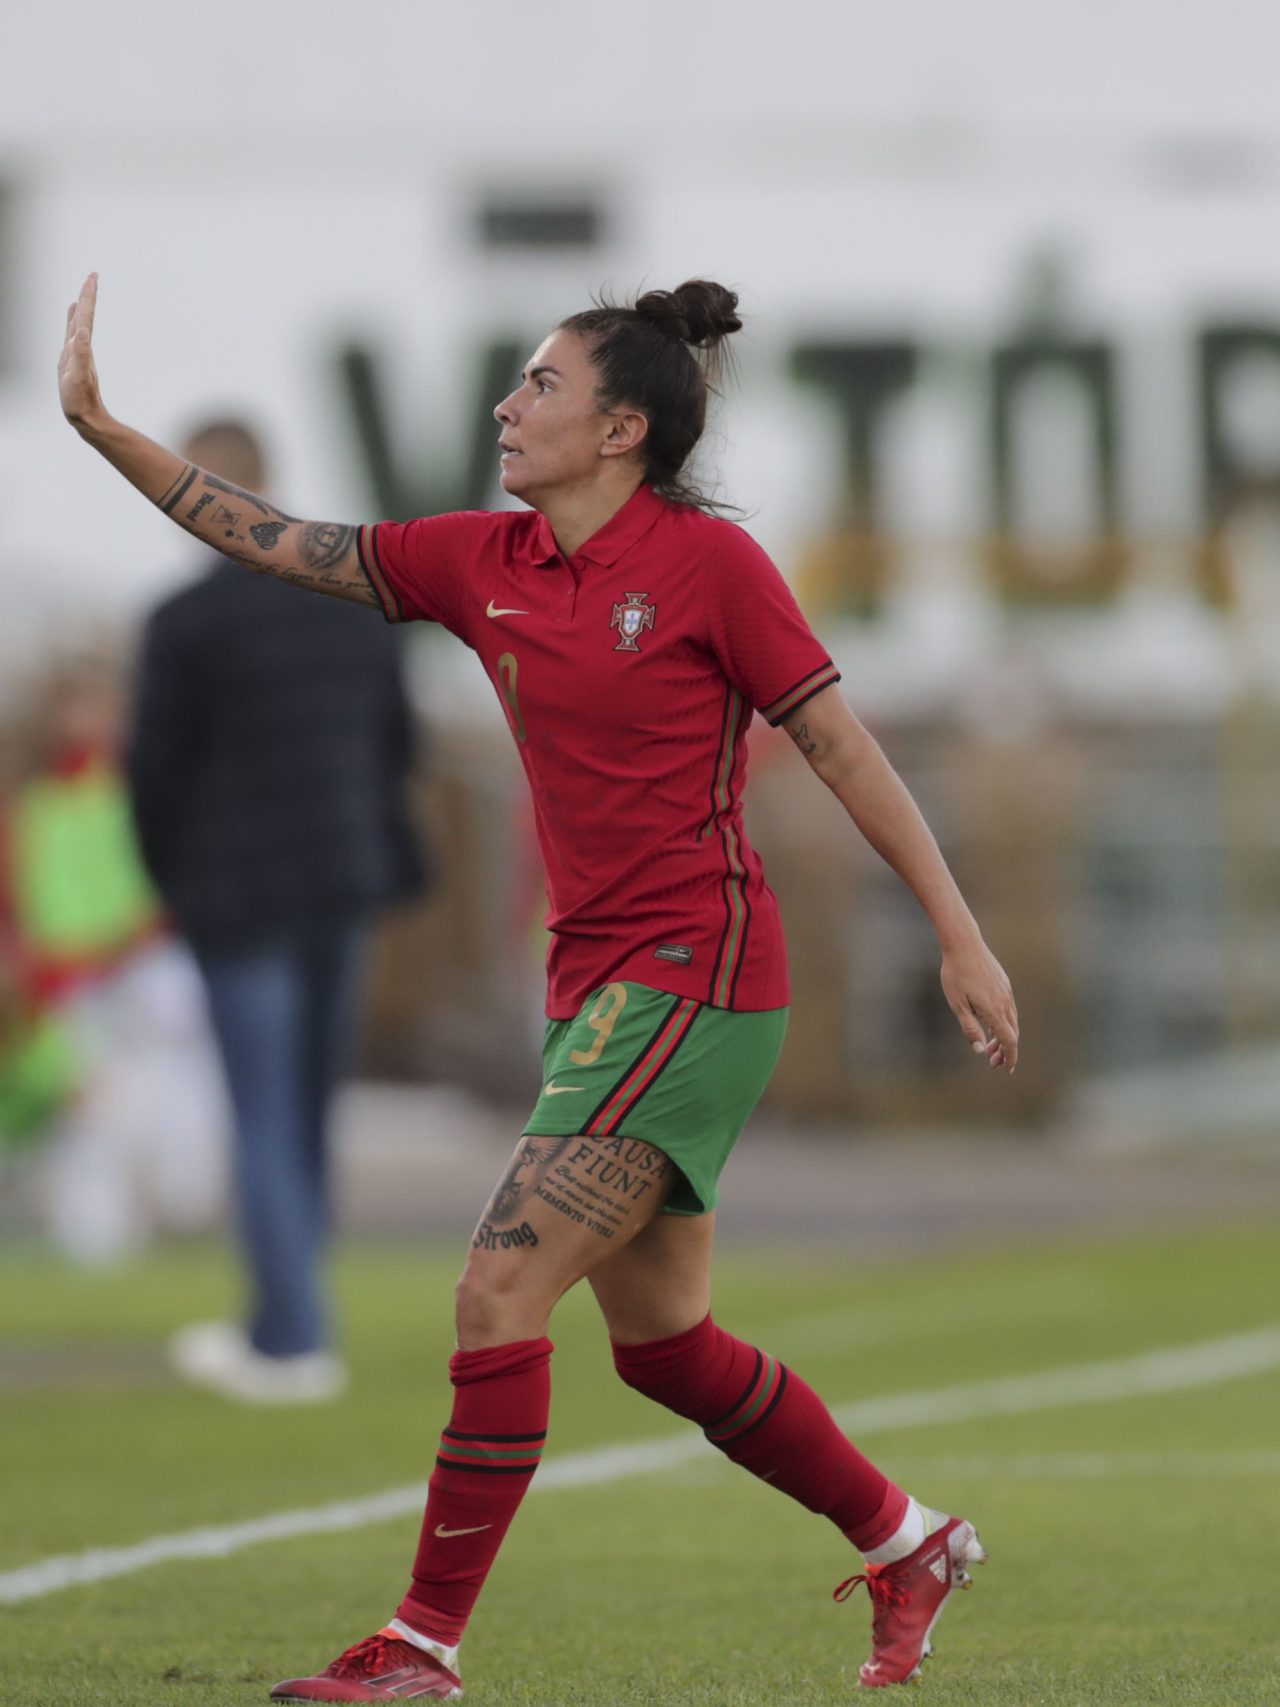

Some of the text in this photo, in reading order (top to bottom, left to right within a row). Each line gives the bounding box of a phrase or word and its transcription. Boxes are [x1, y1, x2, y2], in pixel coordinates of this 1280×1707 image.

[569, 982, 628, 1067] 9
[568, 1143, 652, 1200] FIUNT
[534, 1186, 585, 1223] MEMENTO
[473, 1221, 539, 1251] Strong
